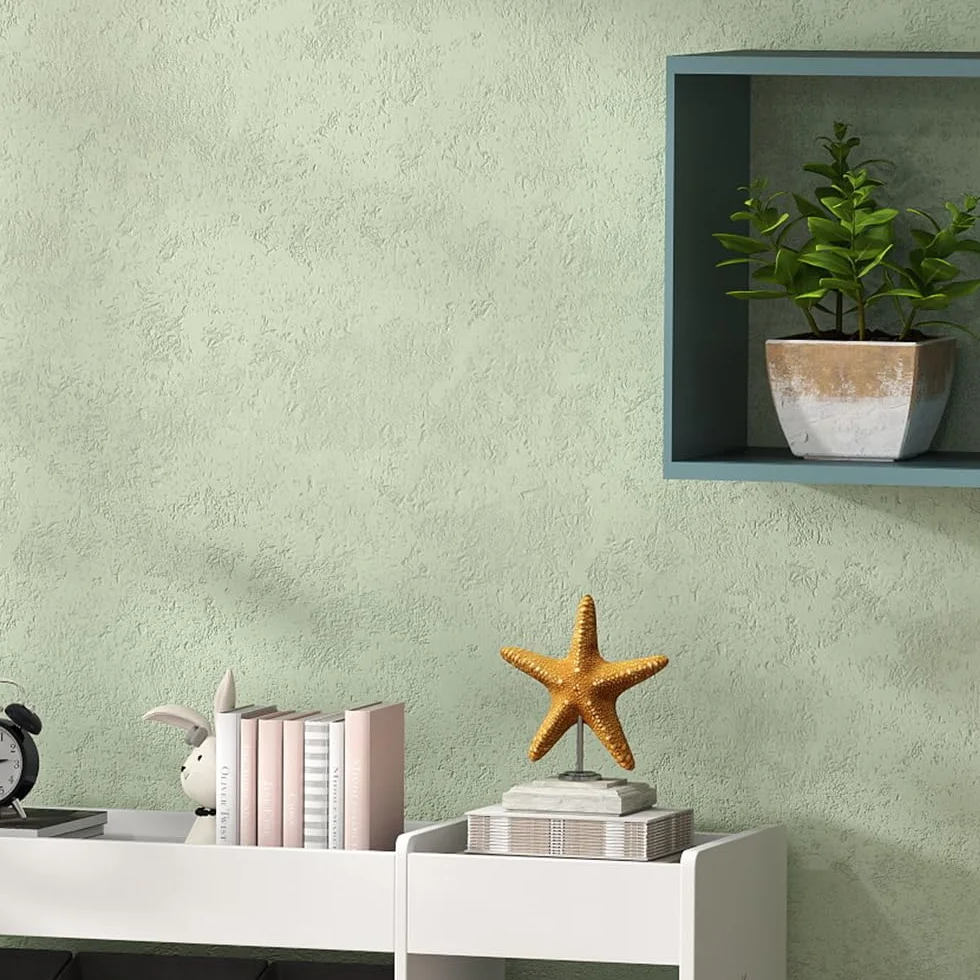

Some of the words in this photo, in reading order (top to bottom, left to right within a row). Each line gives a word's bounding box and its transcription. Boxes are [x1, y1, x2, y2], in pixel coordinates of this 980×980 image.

[10, 743, 17, 753] 2
[14, 759, 20, 769] 3
[8, 775, 14, 783] 4
[0, 785, 5, 795] 5
